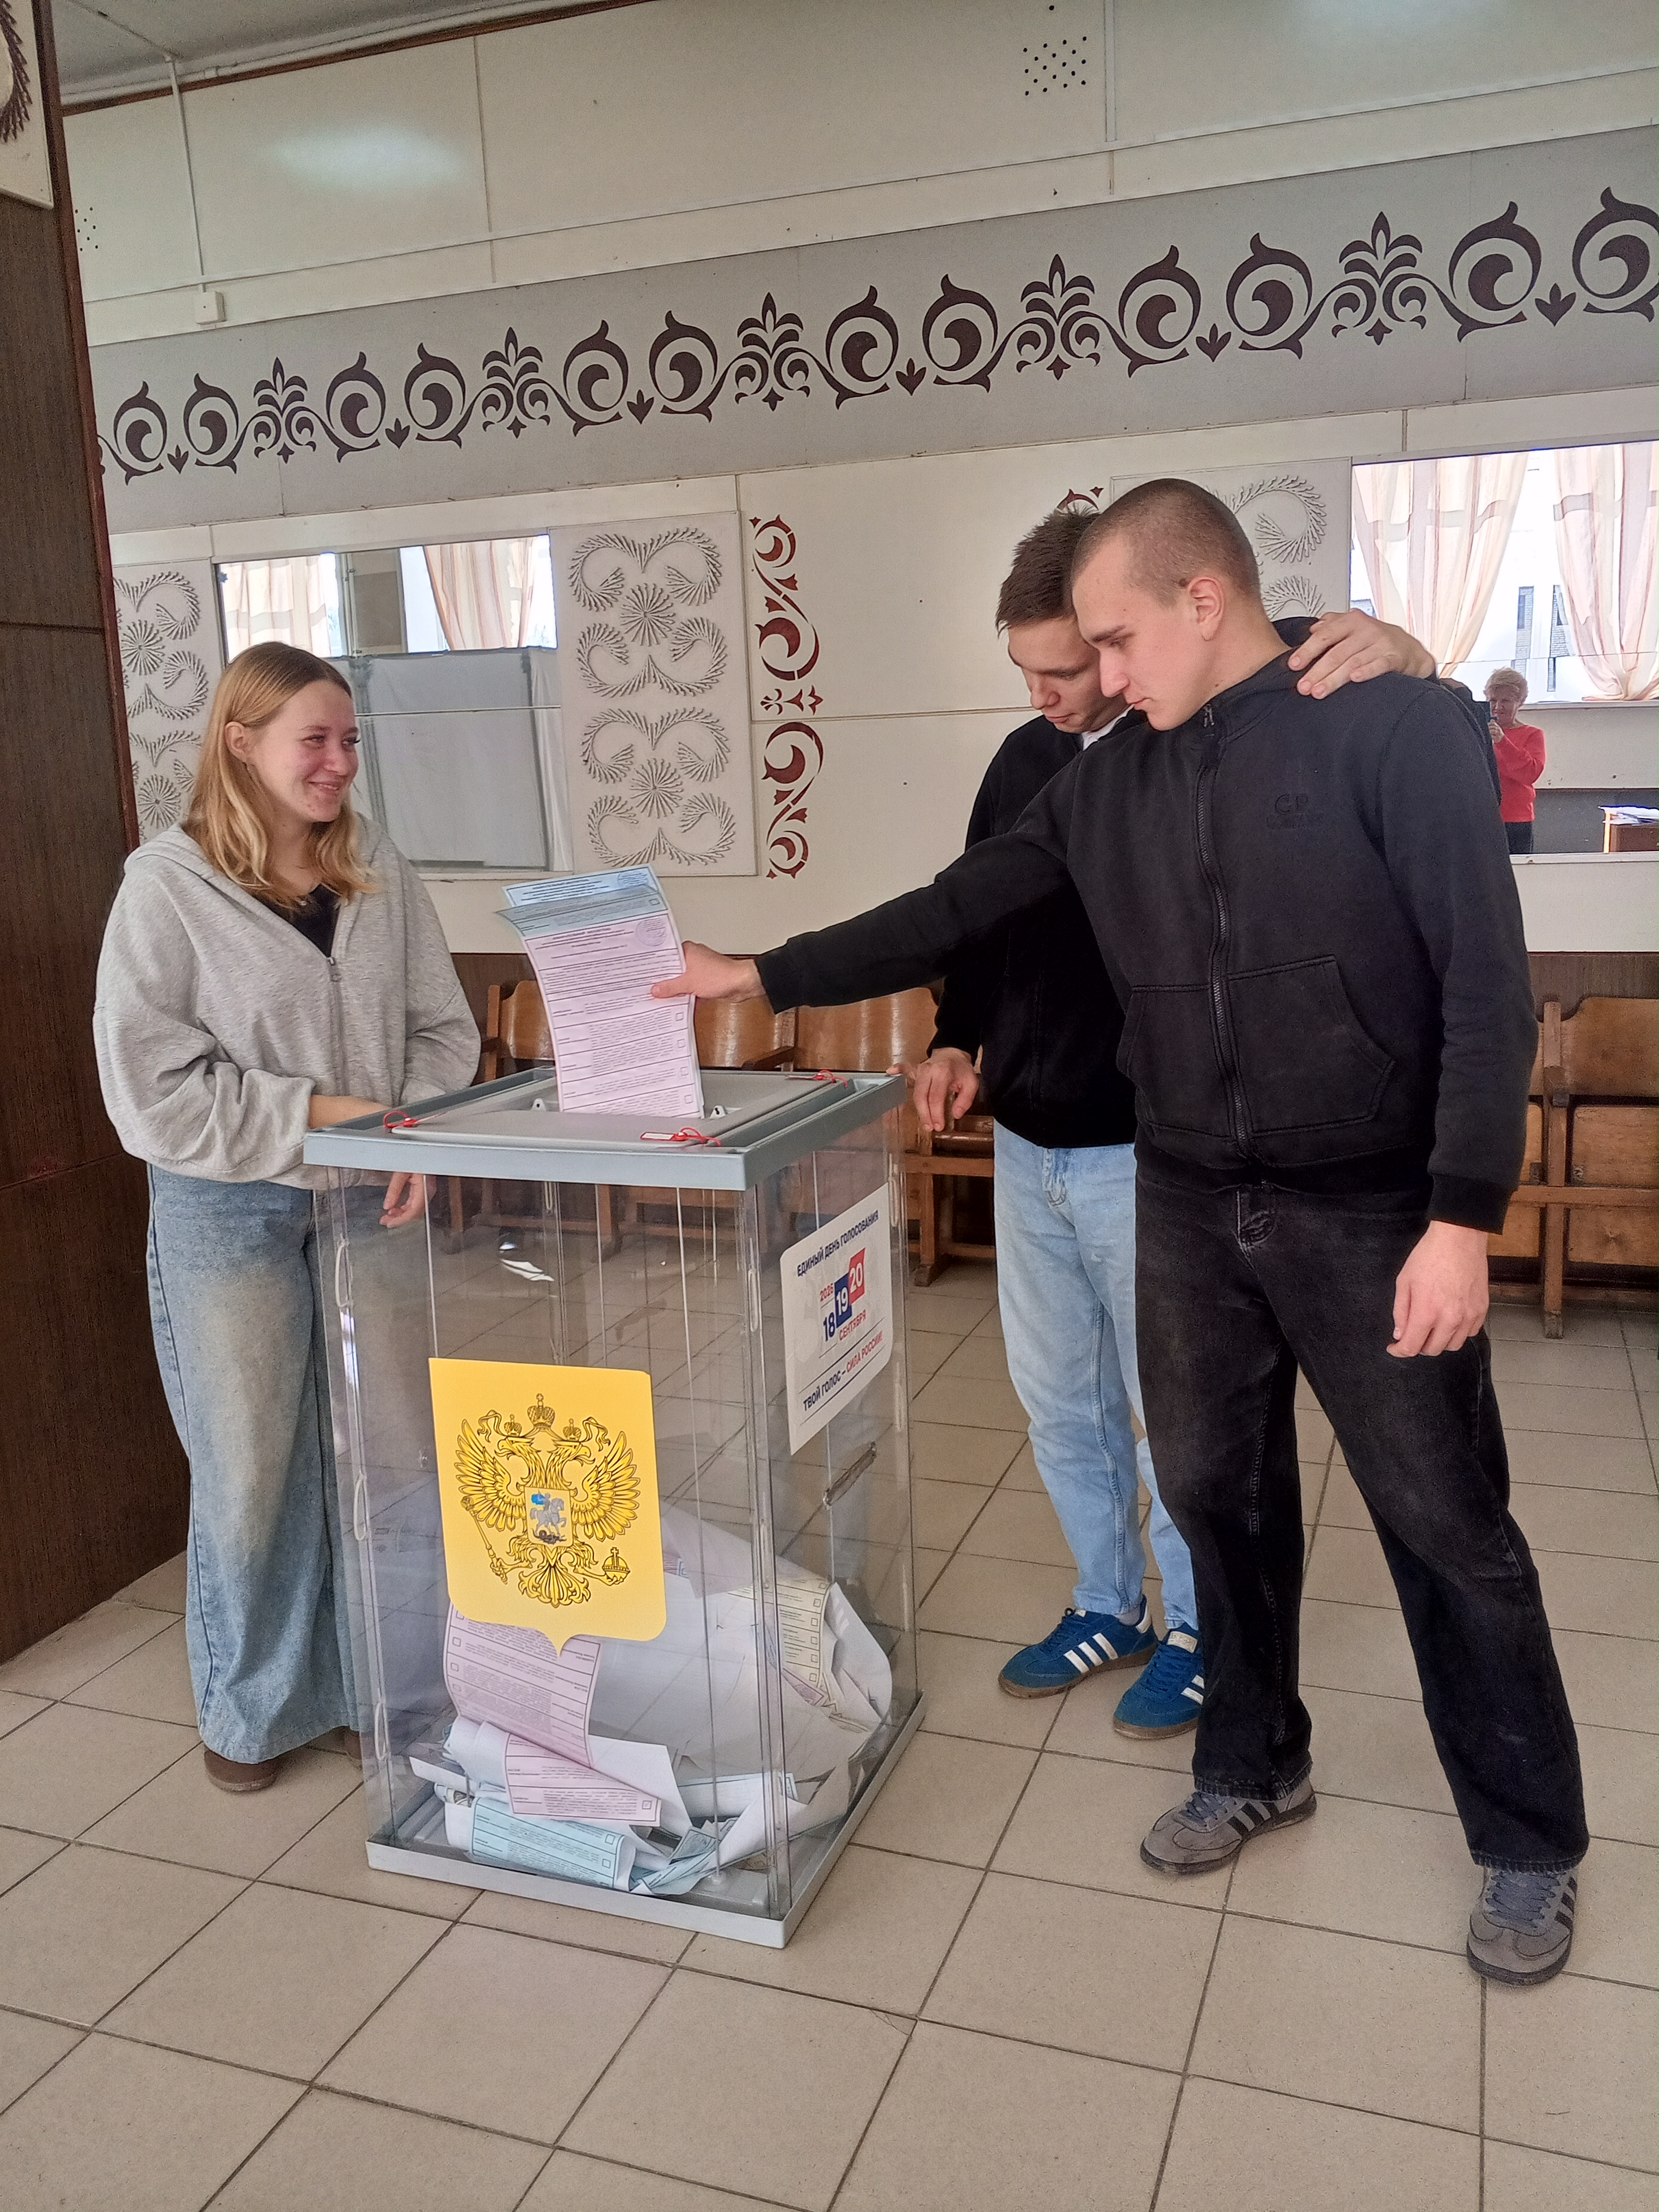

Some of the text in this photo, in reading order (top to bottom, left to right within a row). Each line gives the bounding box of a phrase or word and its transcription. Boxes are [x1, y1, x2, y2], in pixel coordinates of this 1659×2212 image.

[797, 1210, 878, 1277] ЕДИНЫЙ ДЕНЬ ГОЛОСОВАНИЯ
[820, 1282, 834, 1302] 2026
[823, 1262, 863, 1342] 18 19 20
[839, 1309, 867, 1341] СЕНТЯБРЯ
[803, 1385, 820, 1411] ТВОЙ
[821, 1370, 841, 1396] ГОЛОС
[846, 1353, 861, 1373] СИЛА
